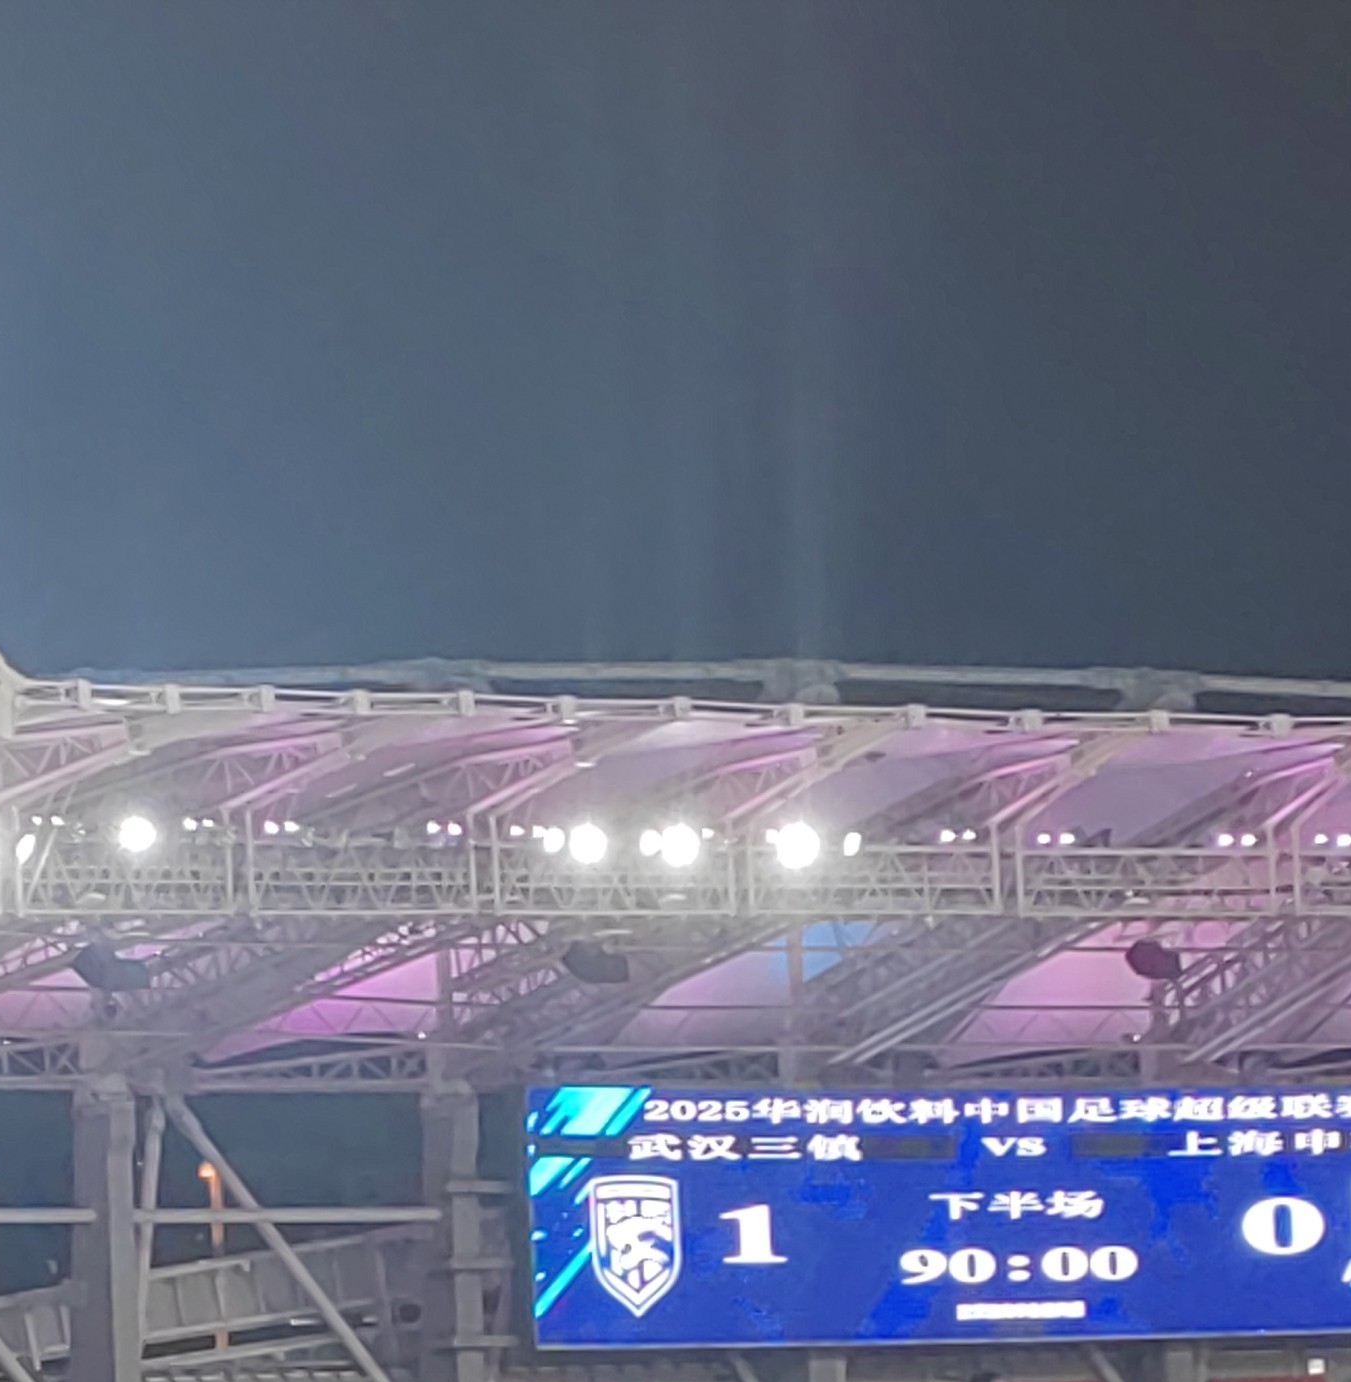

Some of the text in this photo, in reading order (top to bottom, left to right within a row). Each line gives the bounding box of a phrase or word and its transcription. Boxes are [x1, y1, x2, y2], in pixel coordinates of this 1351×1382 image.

[628, 1134, 863, 1161] 武汉三镇
[981, 1136, 1047, 1158] VS
[928, 1190, 1105, 1221] 下半场
[719, 1204, 789, 1264] 1
[1242, 1196, 1325, 1256] 0
[899, 1246, 1138, 1285] 90:00
